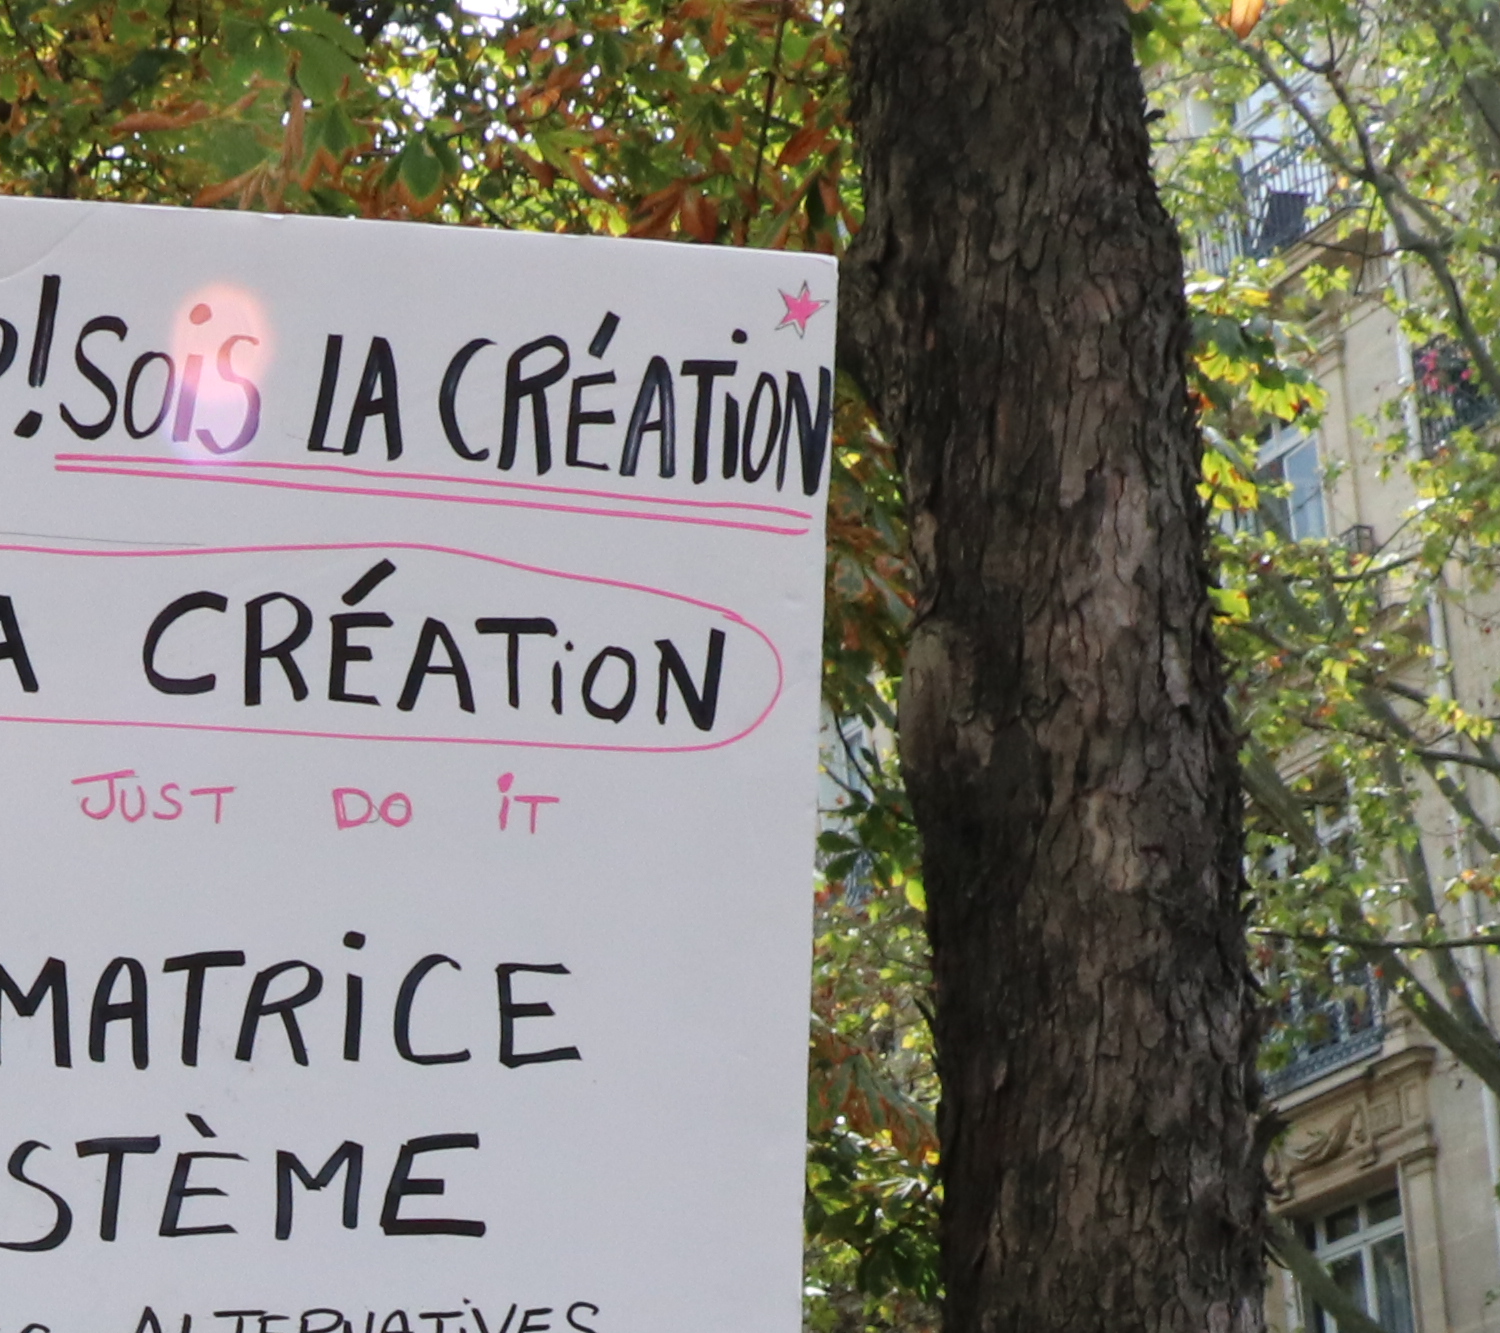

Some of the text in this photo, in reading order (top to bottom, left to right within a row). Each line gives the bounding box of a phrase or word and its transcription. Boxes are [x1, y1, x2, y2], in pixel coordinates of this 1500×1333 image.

[307, 334, 402, 461] LA
[72, 770, 234, 822] JUST
[333, 788, 412, 829] DO
